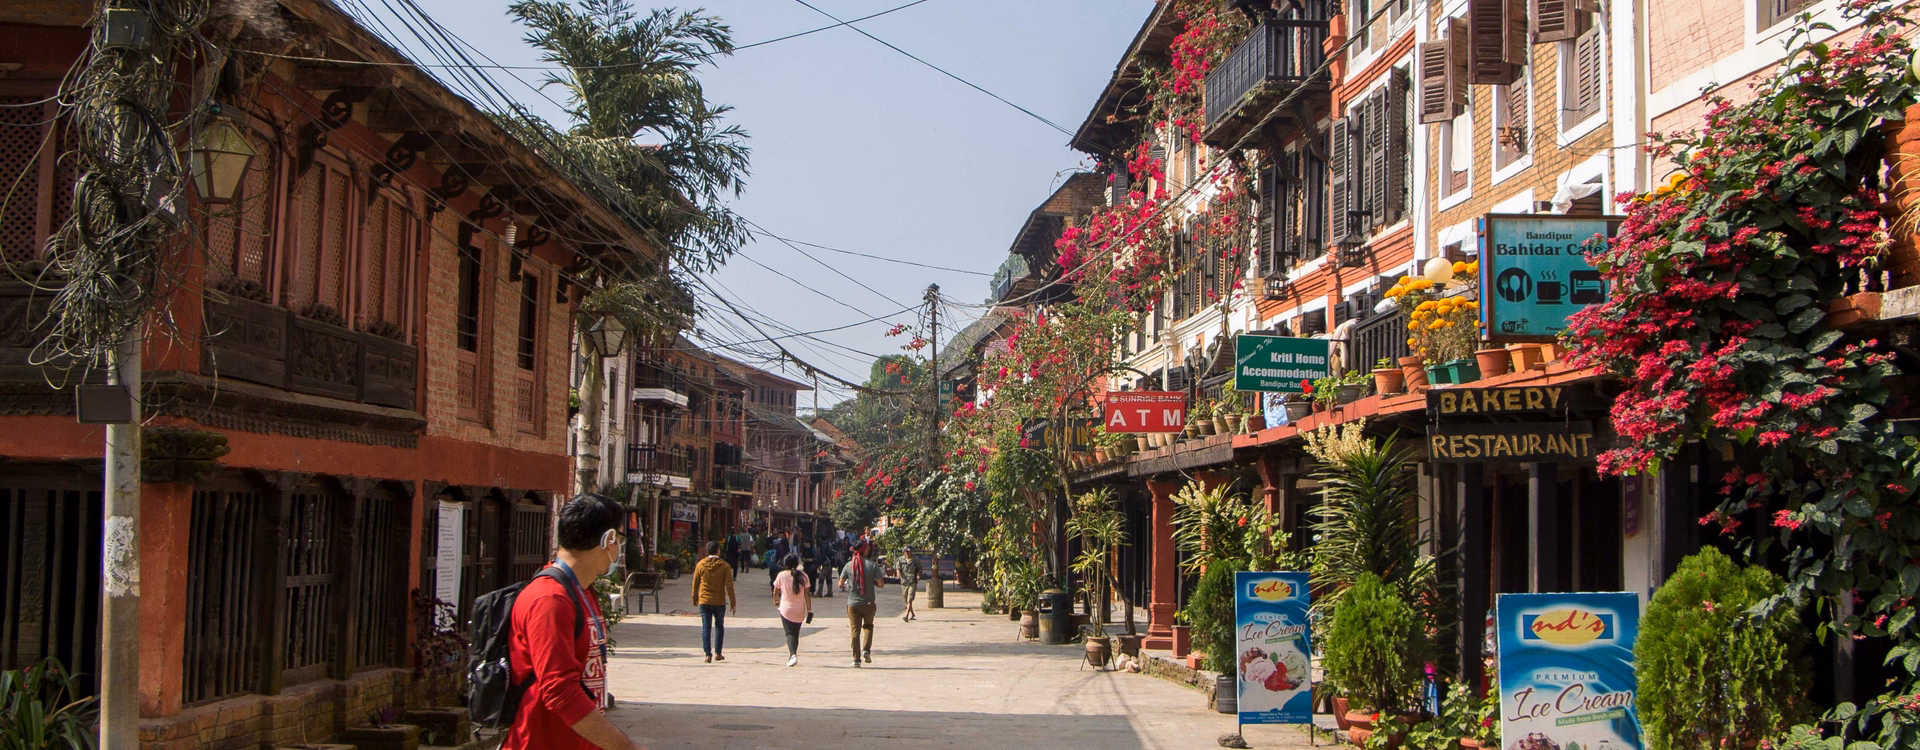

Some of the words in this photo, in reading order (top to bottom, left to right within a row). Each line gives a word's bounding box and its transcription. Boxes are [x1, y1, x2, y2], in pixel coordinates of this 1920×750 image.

[1525, 232, 1574, 241] Bandipur
[1495, 243, 1562, 256] Bahidar
[1270, 352, 1293, 363] Kriti
[1295, 353, 1325, 364] Home
[1242, 365, 1325, 379] Accommodation
[1260, 380, 1288, 388] Bandipur
[1440, 387, 1562, 414] BAKERY
[1431, 433, 1593, 459] RESTAURANT
[1253, 580, 1293, 593] nd's
[1528, 610, 1607, 632] nd's
[1240, 623, 1264, 642] Ice
[1265, 620, 1305, 638] Cream
[1508, 687, 1550, 722] Ice
[1555, 683, 1632, 714] Cream
